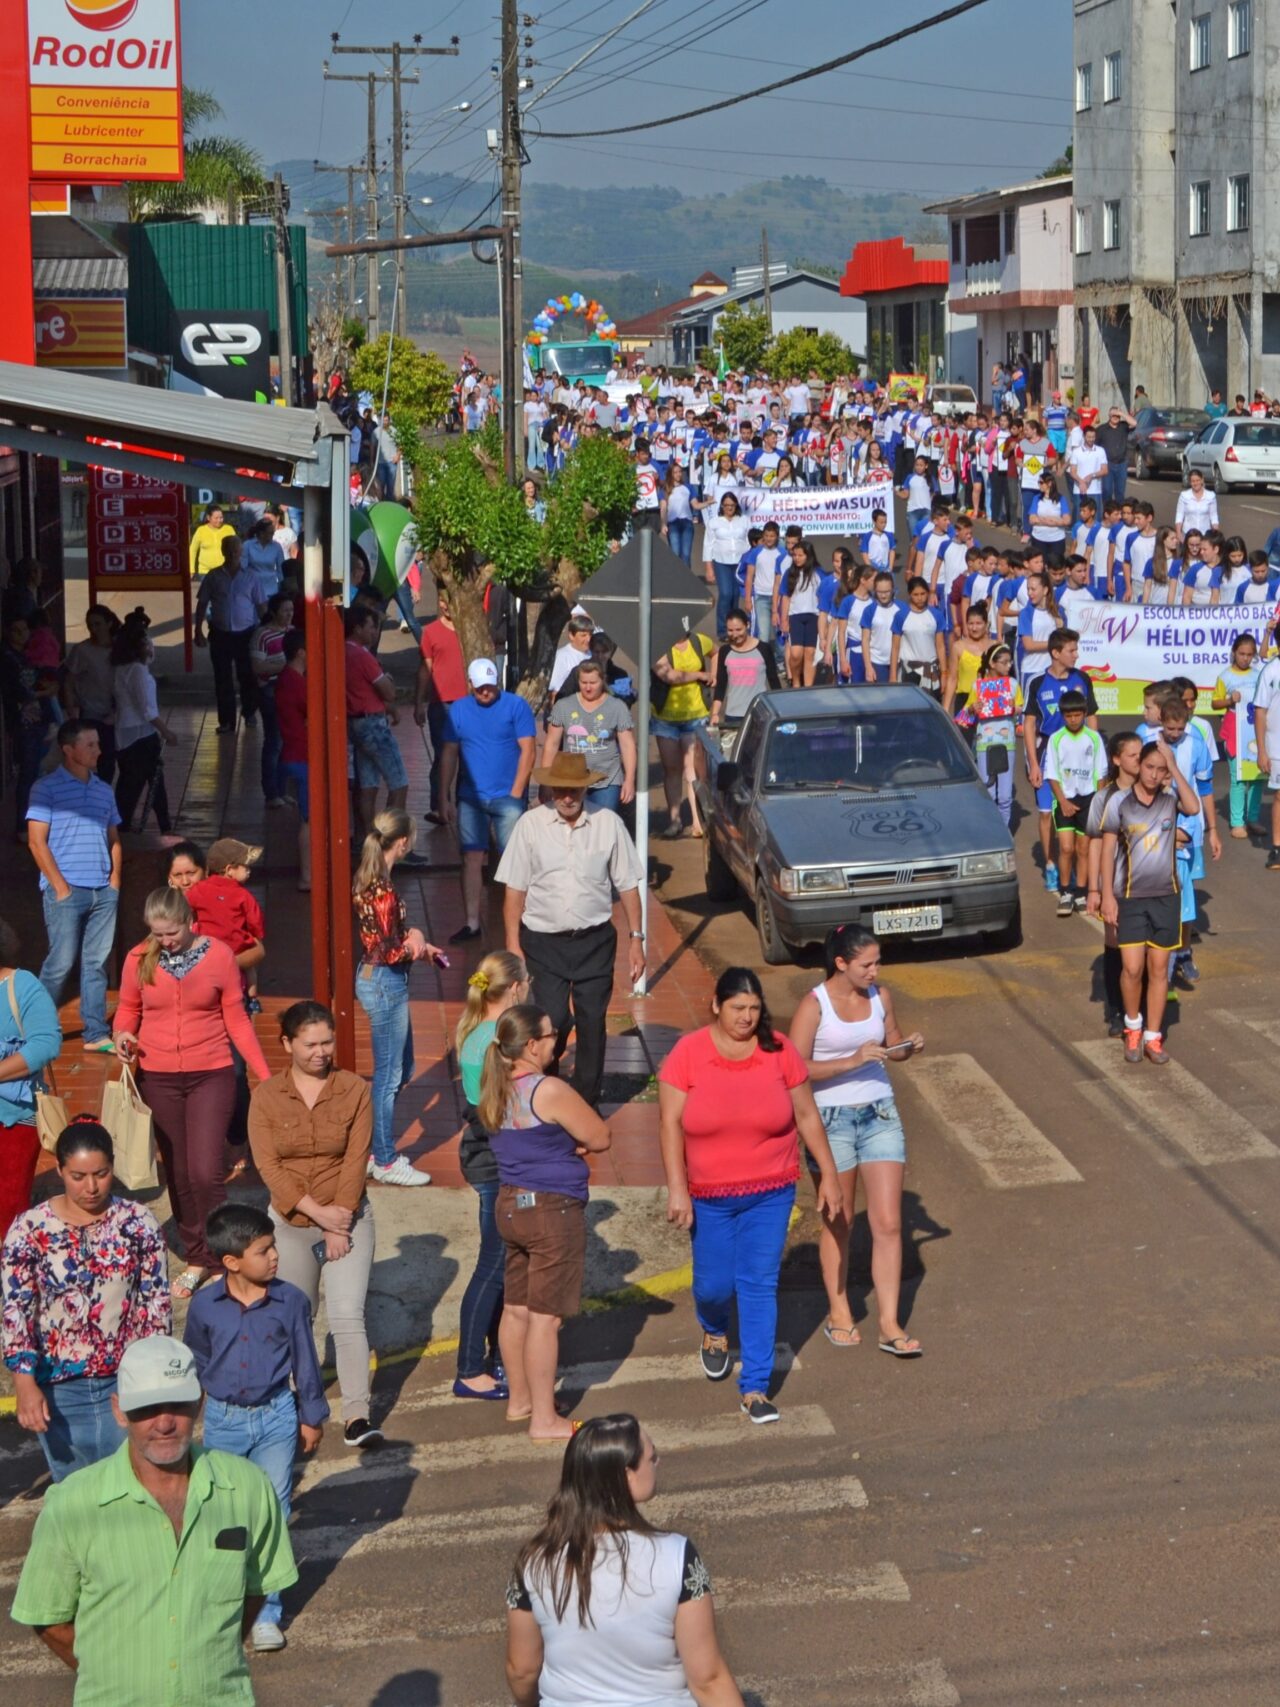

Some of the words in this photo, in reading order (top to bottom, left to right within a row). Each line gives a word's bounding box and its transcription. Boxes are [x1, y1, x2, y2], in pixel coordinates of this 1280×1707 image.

[32, 36, 173, 70] RodOil
[56, 95, 150, 110] Conveniência
[64, 124, 144, 138] Lubricenter
[63, 153, 147, 166] Borracharia
[773, 493, 820, 512] HÉLIO
[825, 496, 886, 510] WASUM
[751, 513, 798, 524] EDUCAÇÃO
[816, 512, 860, 522] TRÂNSITO:
[1143, 606, 1185, 620] ESCOLA
[1188, 604, 1250, 624] EDUCAÇÃO
[1146, 622, 1206, 646] HÉLIO
[1163, 653, 1189, 664] SUL
[860, 809, 919, 821] ROTA
[872, 817, 925, 834] 66
[877, 918, 902, 931] LXS
[906, 914, 939, 928] 7216
